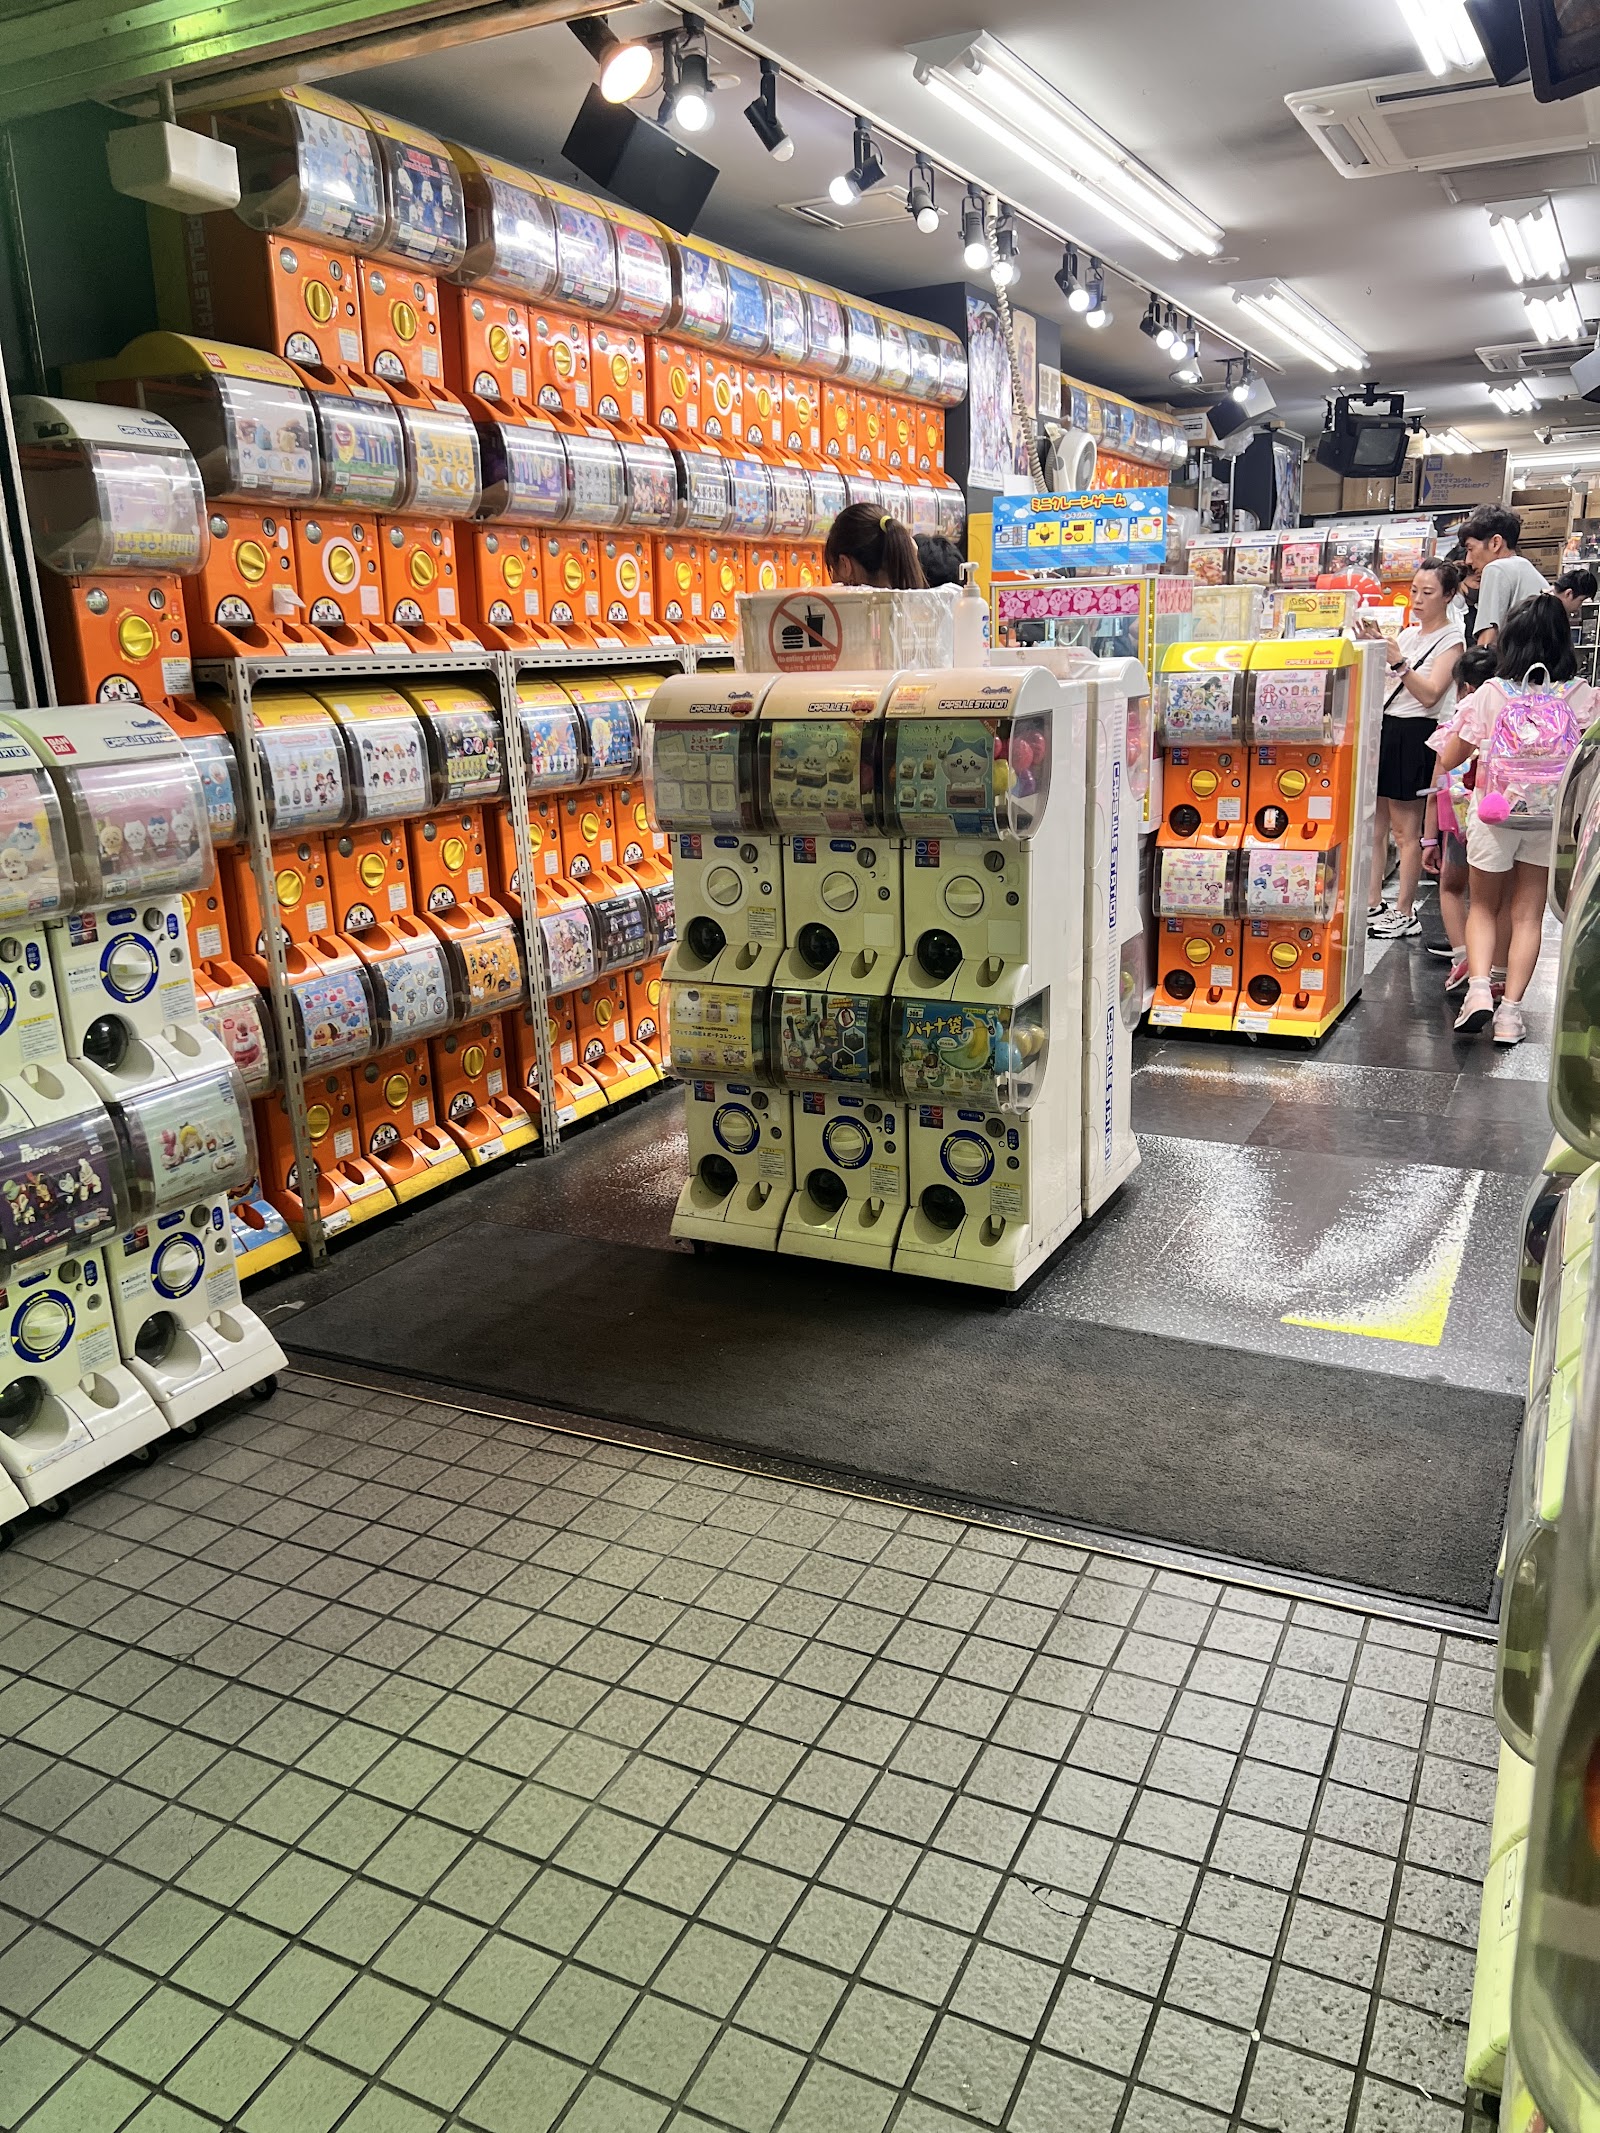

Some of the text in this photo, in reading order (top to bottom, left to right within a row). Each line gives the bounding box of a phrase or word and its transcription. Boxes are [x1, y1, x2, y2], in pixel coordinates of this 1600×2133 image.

[1032, 492, 1126, 512] ミニクレーンゲーム
[786, 655, 804, 664] eating
[812, 652, 837, 662] drinking
[47, 737, 69, 745] BAN
[54, 744, 71, 754] DAI
[906, 1016, 963, 1038] バナナ袋
